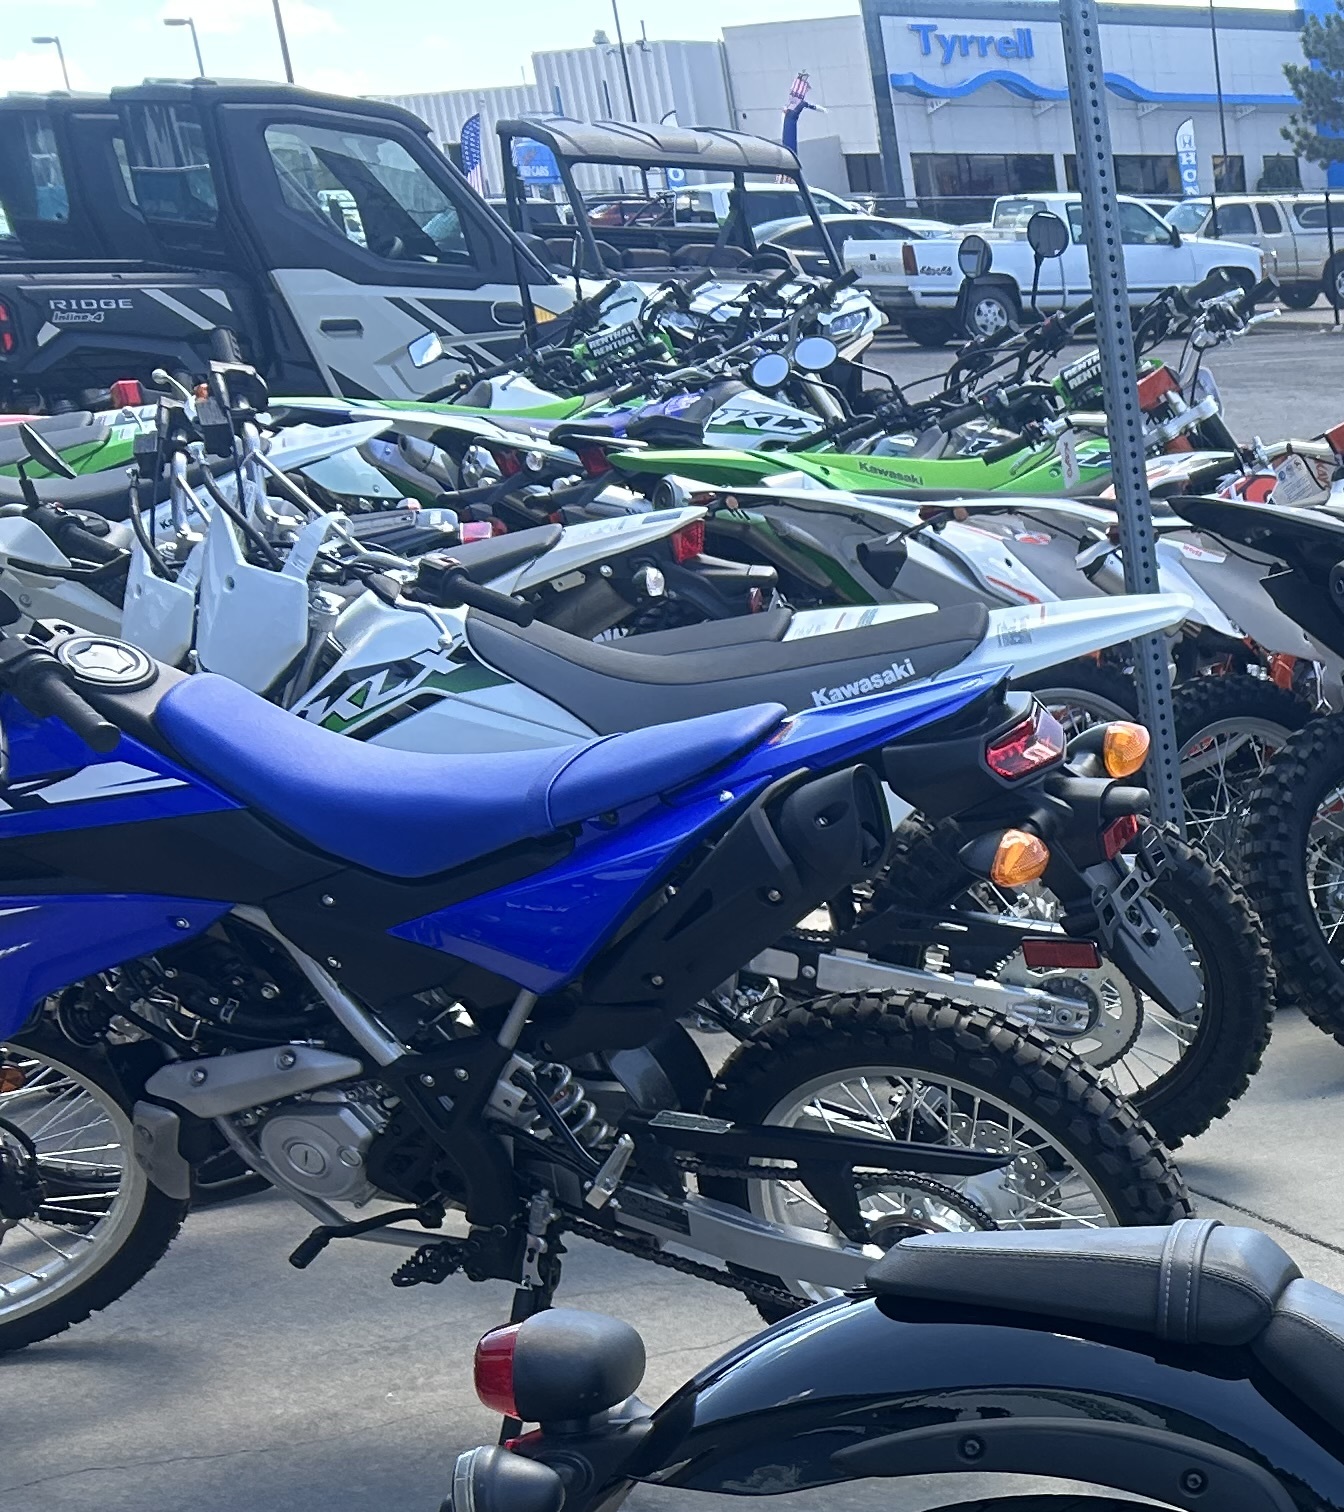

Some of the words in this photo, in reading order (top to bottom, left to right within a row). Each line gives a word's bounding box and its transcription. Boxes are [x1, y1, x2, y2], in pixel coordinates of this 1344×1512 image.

[908, 24, 1034, 65] Tyrrell
[49, 299, 134, 310] RIDGE
[859, 461, 924, 486] Kawasaki
[811, 658, 916, 707] Kawasaki
